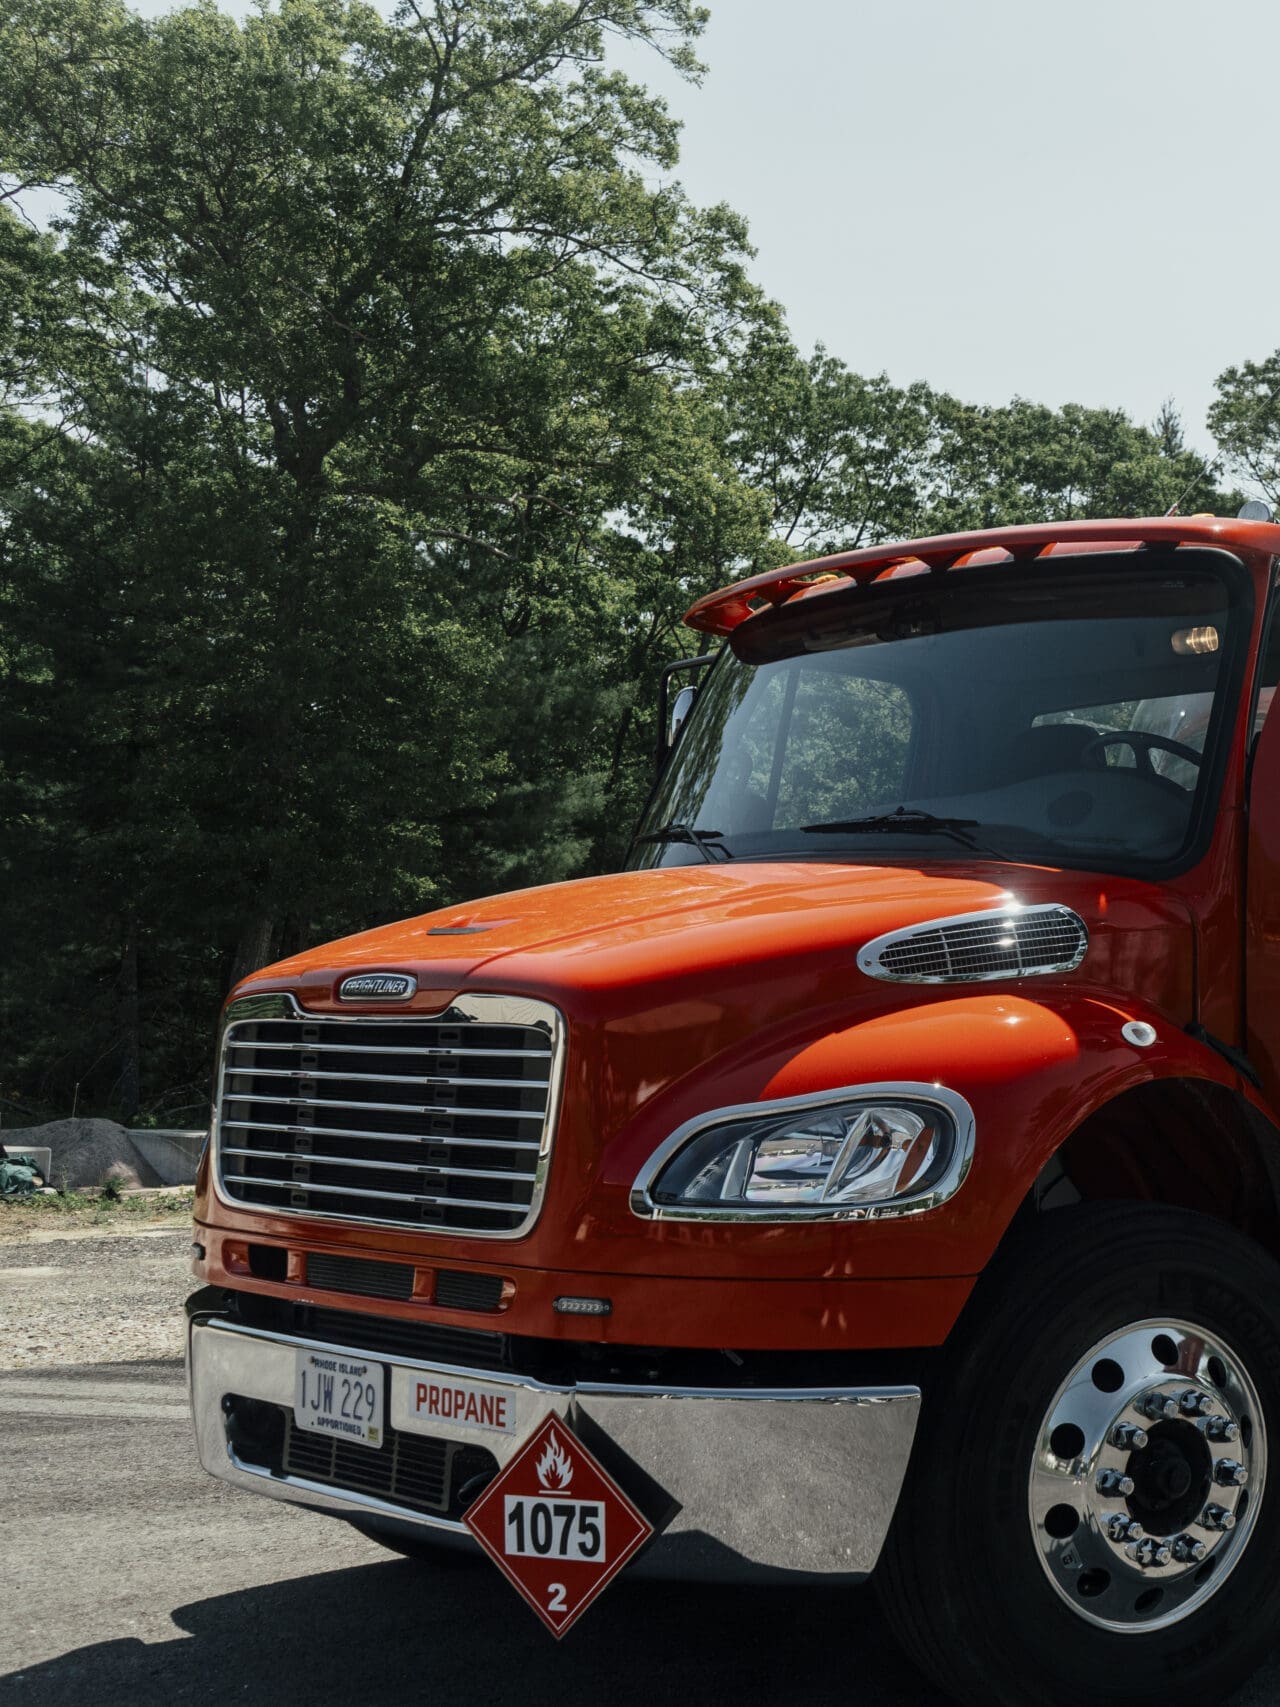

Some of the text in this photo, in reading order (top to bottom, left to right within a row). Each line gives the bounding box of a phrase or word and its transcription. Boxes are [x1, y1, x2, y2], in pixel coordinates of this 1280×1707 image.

[344, 979, 407, 994] FREIGHTLINER
[314, 1358, 363, 1377] RHODE ISLAND
[341, 1378, 376, 1423] 229
[416, 1382, 507, 1428] PROPANE
[317, 1416, 362, 1436] APPORTIONED
[508, 1501, 601, 1558] 1075
[547, 1583, 568, 1612] 2
